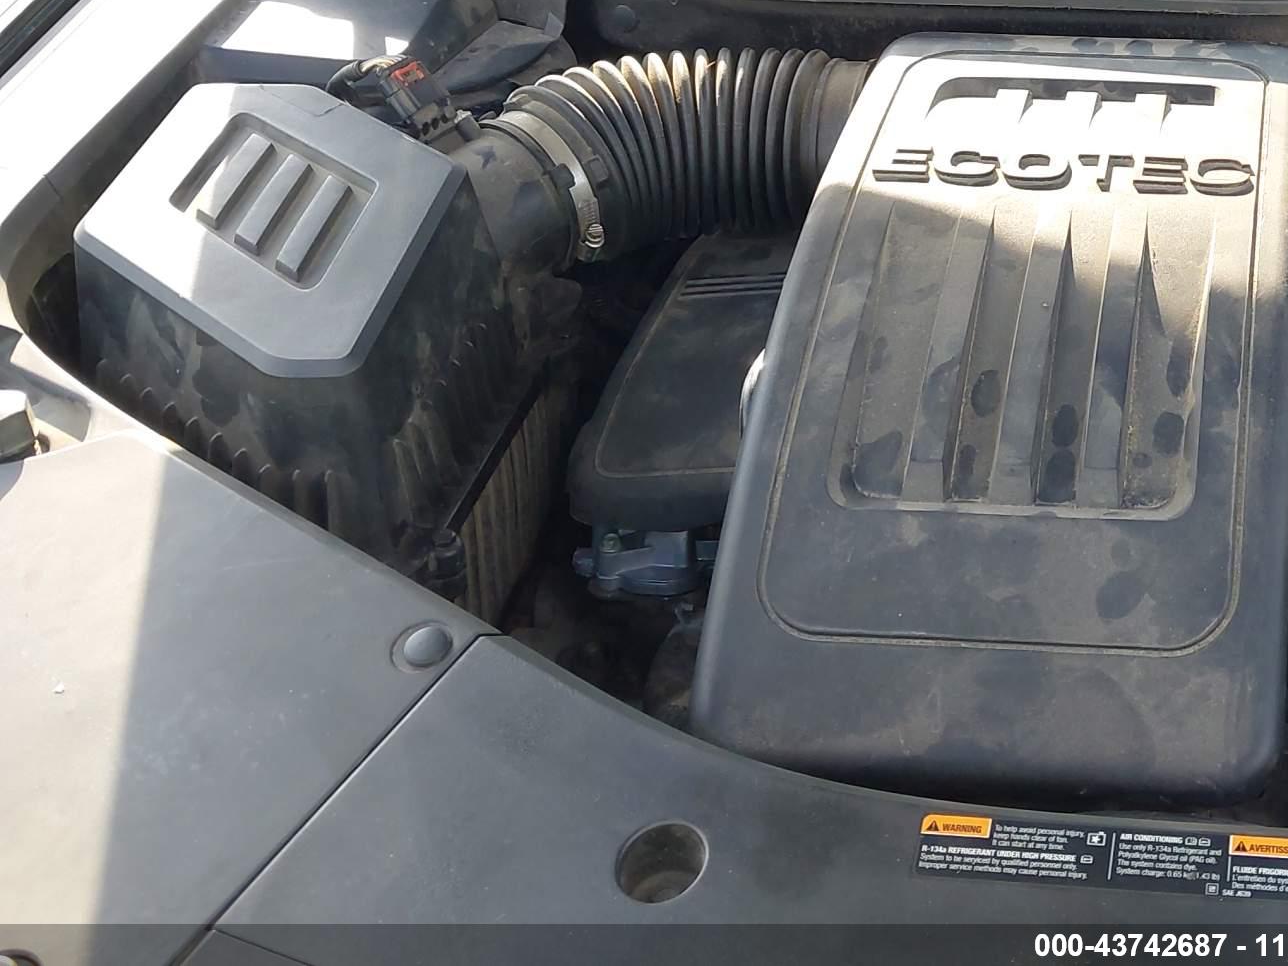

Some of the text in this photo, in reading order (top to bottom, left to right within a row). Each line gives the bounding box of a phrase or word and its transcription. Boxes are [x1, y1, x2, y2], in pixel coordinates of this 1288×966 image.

[872, 147, 1255, 197] ECOTEC
[942, 823, 982, 834] WARNING
[996, 824, 1002, 832] To
[1003, 826, 1018, 834] help
[1037, 828, 1065, 836] personal
[1120, 833, 1183, 844] AIR CONDITIONING
[1132, 844, 1146, 852] only
[948, 846, 996, 856] REFRIGERANT
[997, 849, 1020, 858] UNDER
[1021, 851, 1039, 859] HIGH
[1040, 852, 1076, 862] PRESSURE
[920, 853, 944, 861] System
[946, 854, 952, 862] to
[962, 856, 991, 864] serviced
[991, 857, 1000, 866] by
[1001, 858, 1029, 867] qualified
[1029, 860, 1062, 868] personnel
[1130, 860, 1154, 868] system
[1155, 862, 1182, 870] contains
[919, 860, 948, 869] Improper
[973, 865, 1002, 873] methods
[1116, 866, 1140, 875] System
[1232, 866, 1257, 874] FLUIDE
[1246, 883, 1278, 891] méthodes
